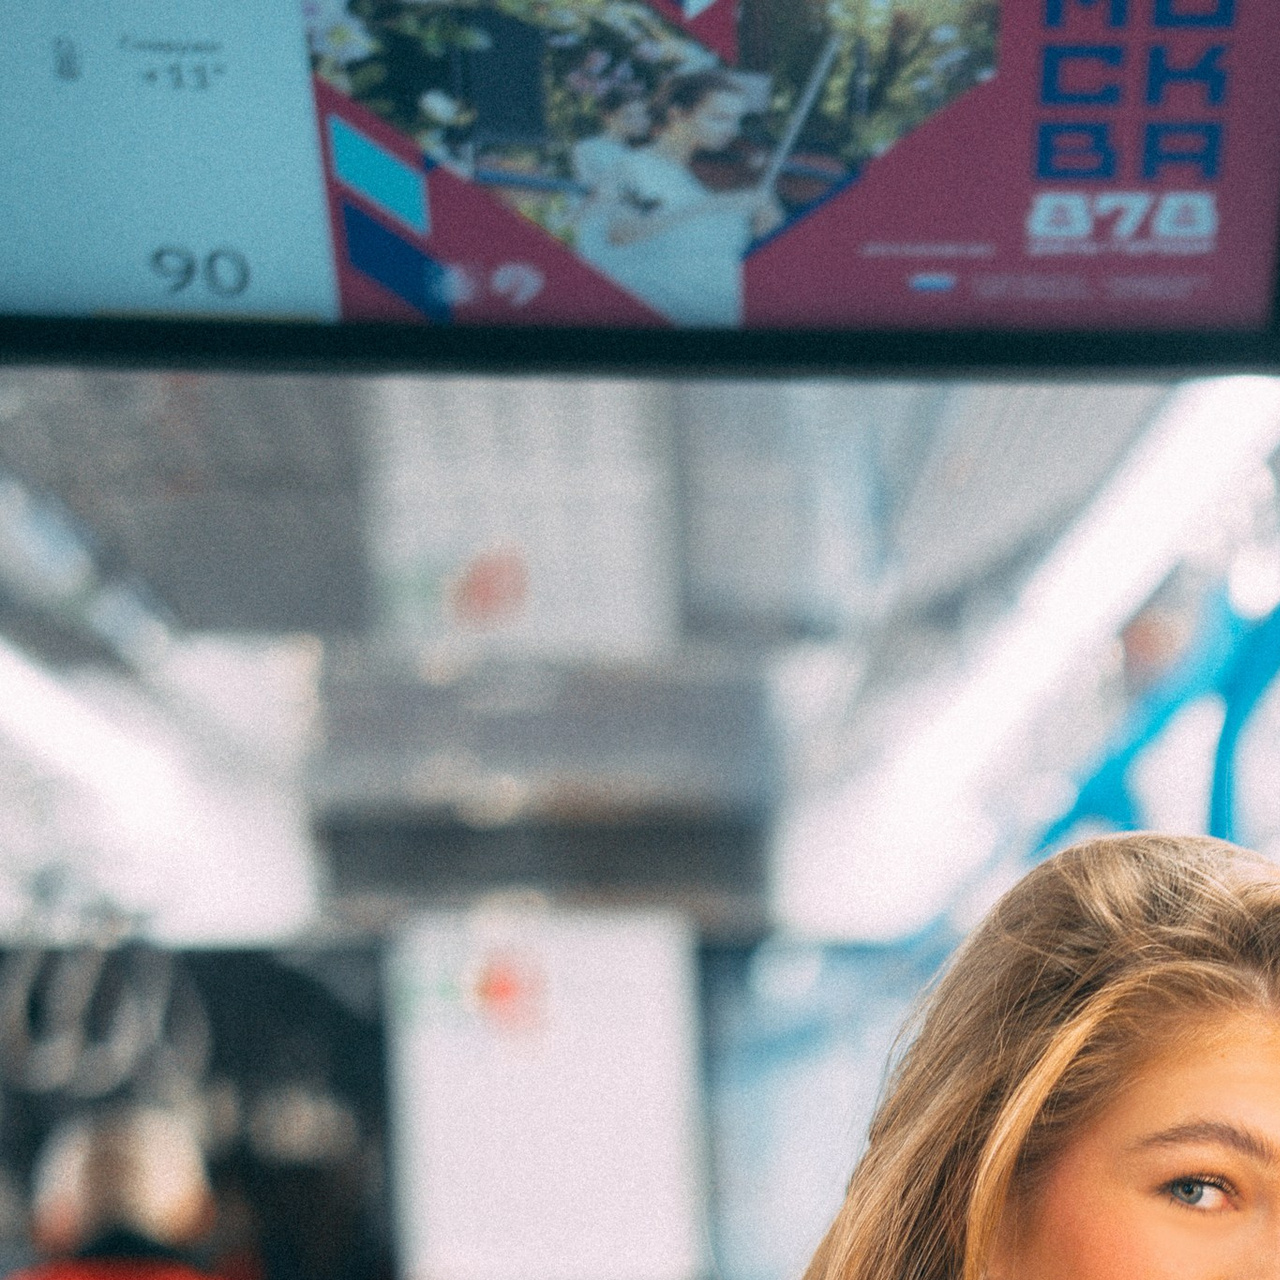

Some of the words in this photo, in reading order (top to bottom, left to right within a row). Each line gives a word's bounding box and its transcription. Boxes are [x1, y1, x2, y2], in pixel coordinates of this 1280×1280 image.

[1040, 45, 1228, 103] СК
[1036, 121, 1222, 180] ВА
[150, 246, 251, 298] 90
